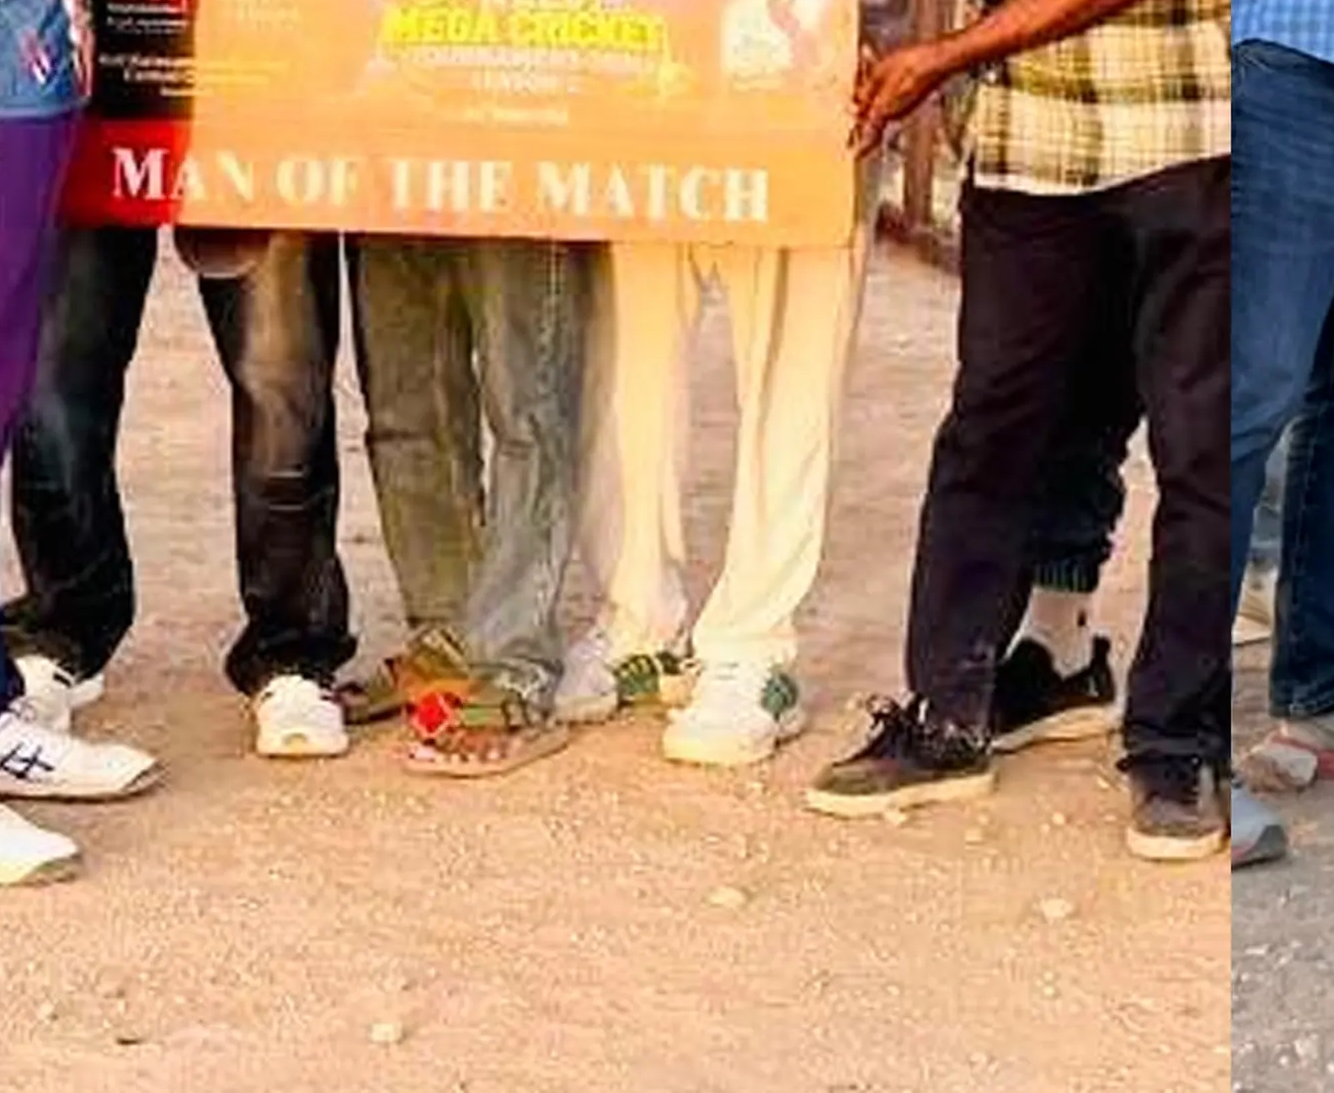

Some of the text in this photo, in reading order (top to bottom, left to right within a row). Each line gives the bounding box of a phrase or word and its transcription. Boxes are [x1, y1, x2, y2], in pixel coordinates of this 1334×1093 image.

[111, 147, 768, 223] MAN OF THE MATCH
